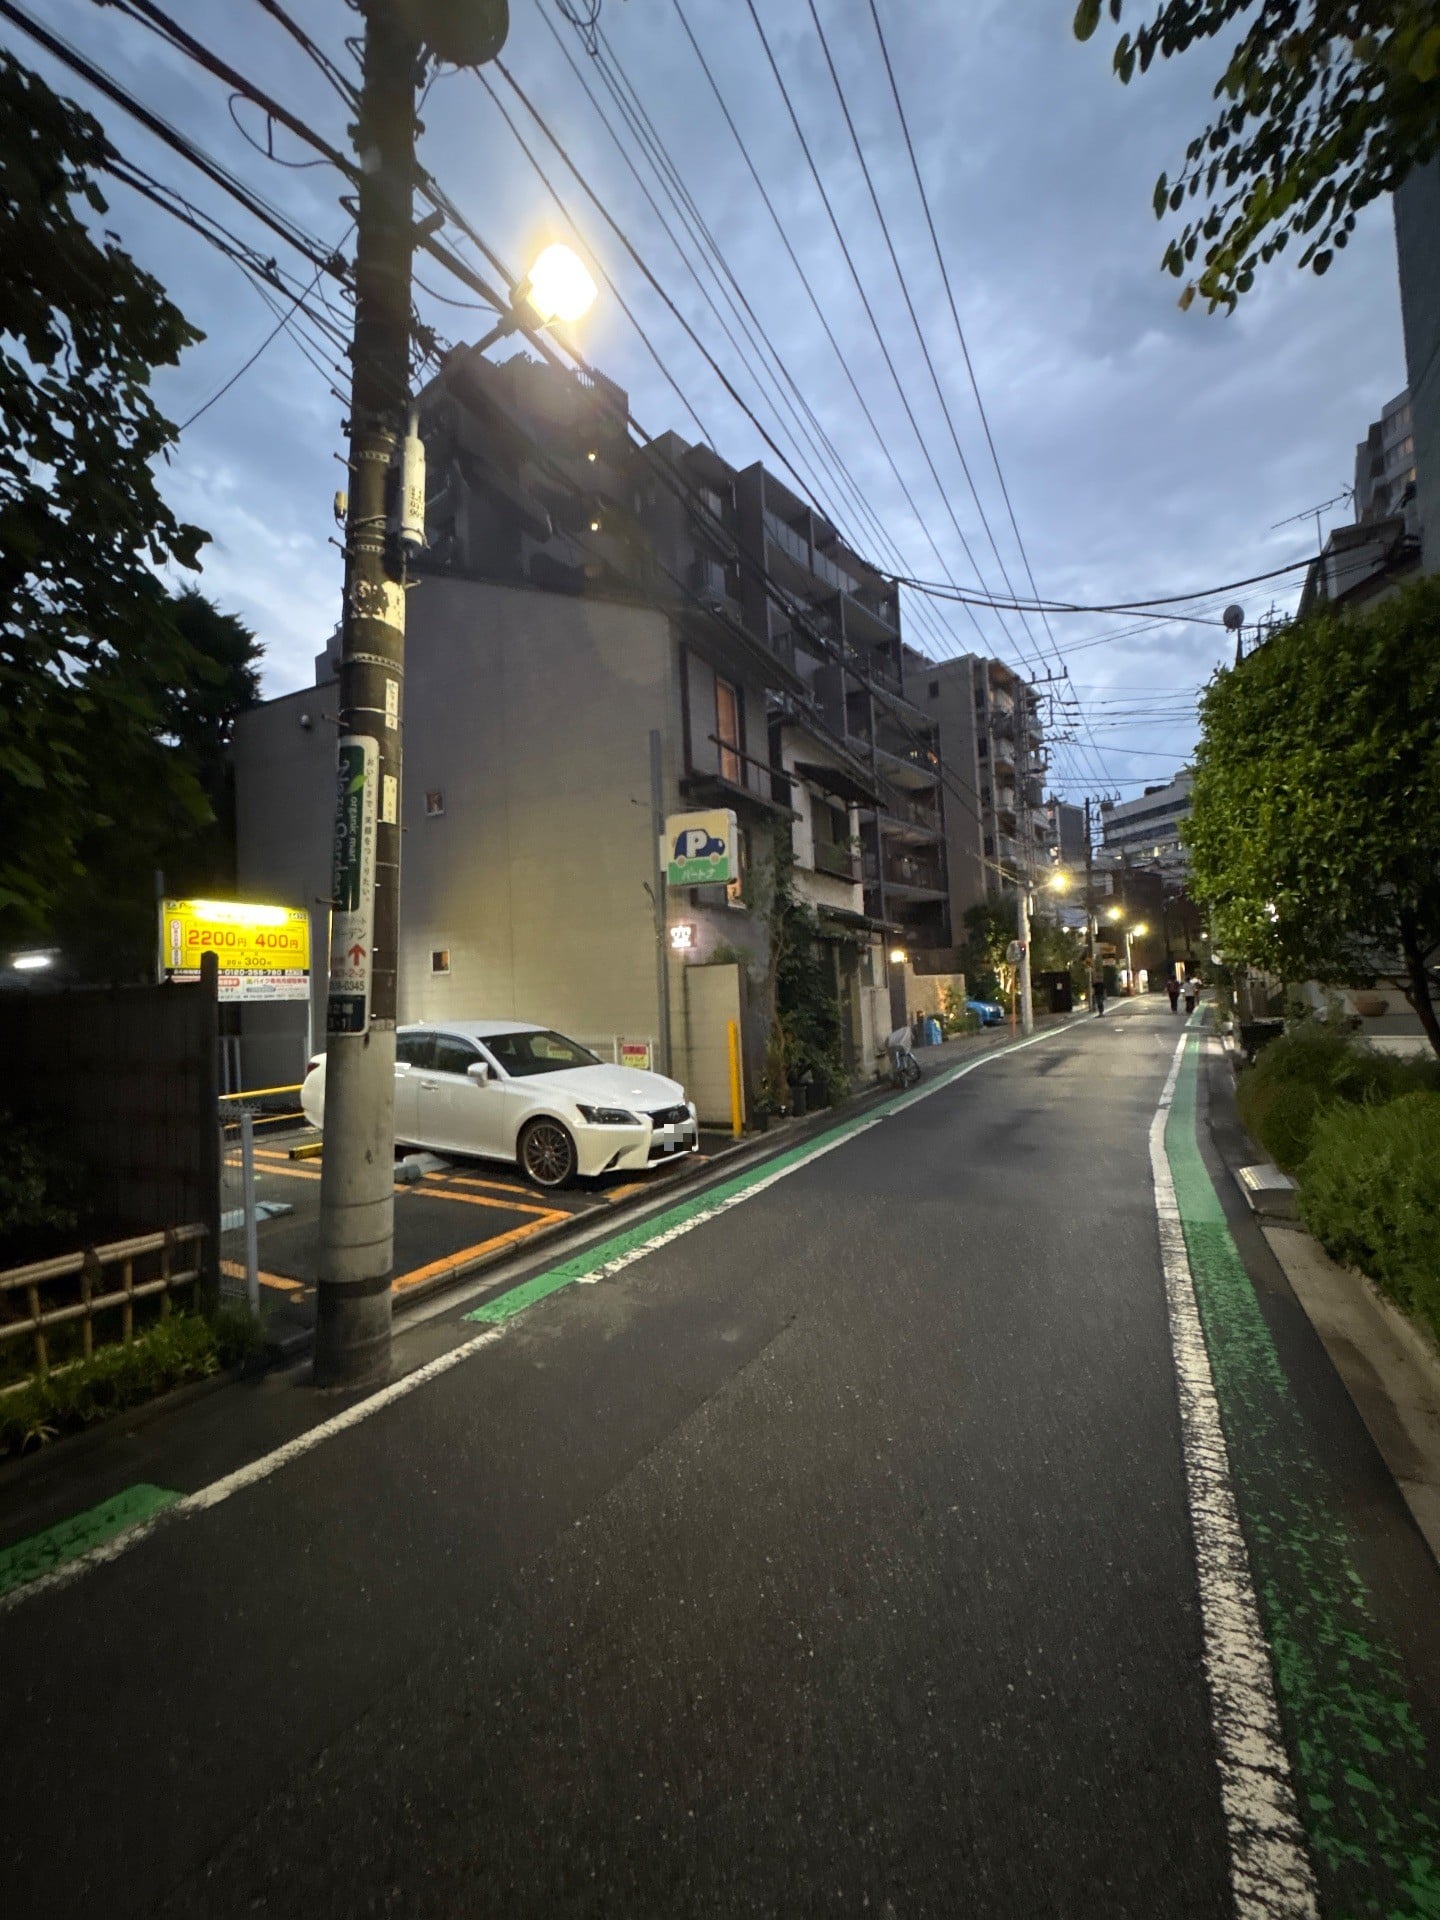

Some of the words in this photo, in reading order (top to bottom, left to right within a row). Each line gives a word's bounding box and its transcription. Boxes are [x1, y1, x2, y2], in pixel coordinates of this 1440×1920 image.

[349, 796, 360, 834] organic
[348, 837, 359, 863] mart
[686, 830, 708, 858] P
[188, 929, 247, 947] 2200円
[255, 933, 299, 949] 400円
